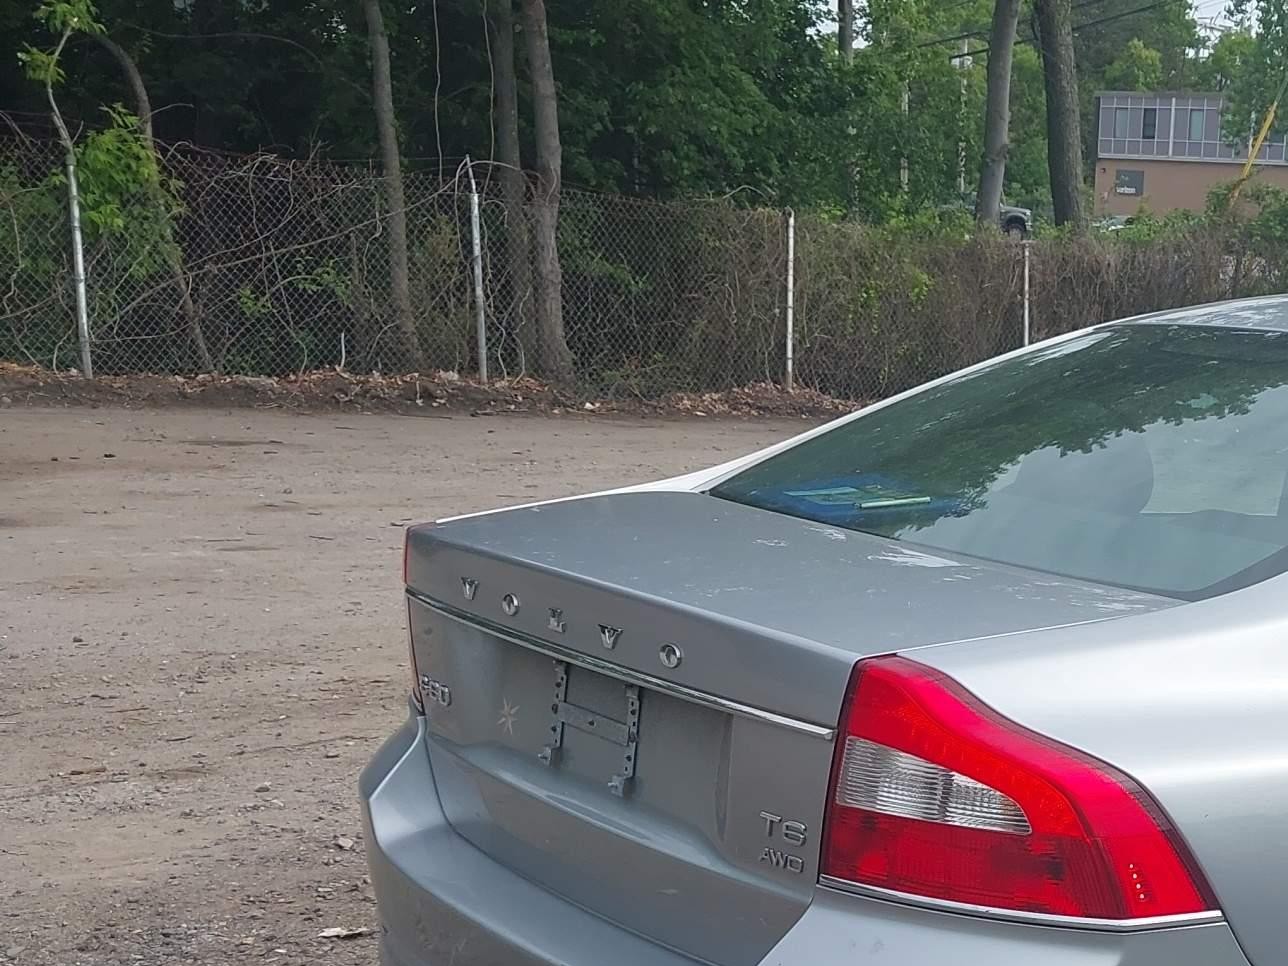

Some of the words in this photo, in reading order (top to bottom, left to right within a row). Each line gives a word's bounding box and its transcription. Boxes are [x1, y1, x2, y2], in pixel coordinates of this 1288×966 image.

[461, 576, 682, 669] VOLVO
[760, 810, 806, 847] T6
[759, 848, 804, 873] AWD
